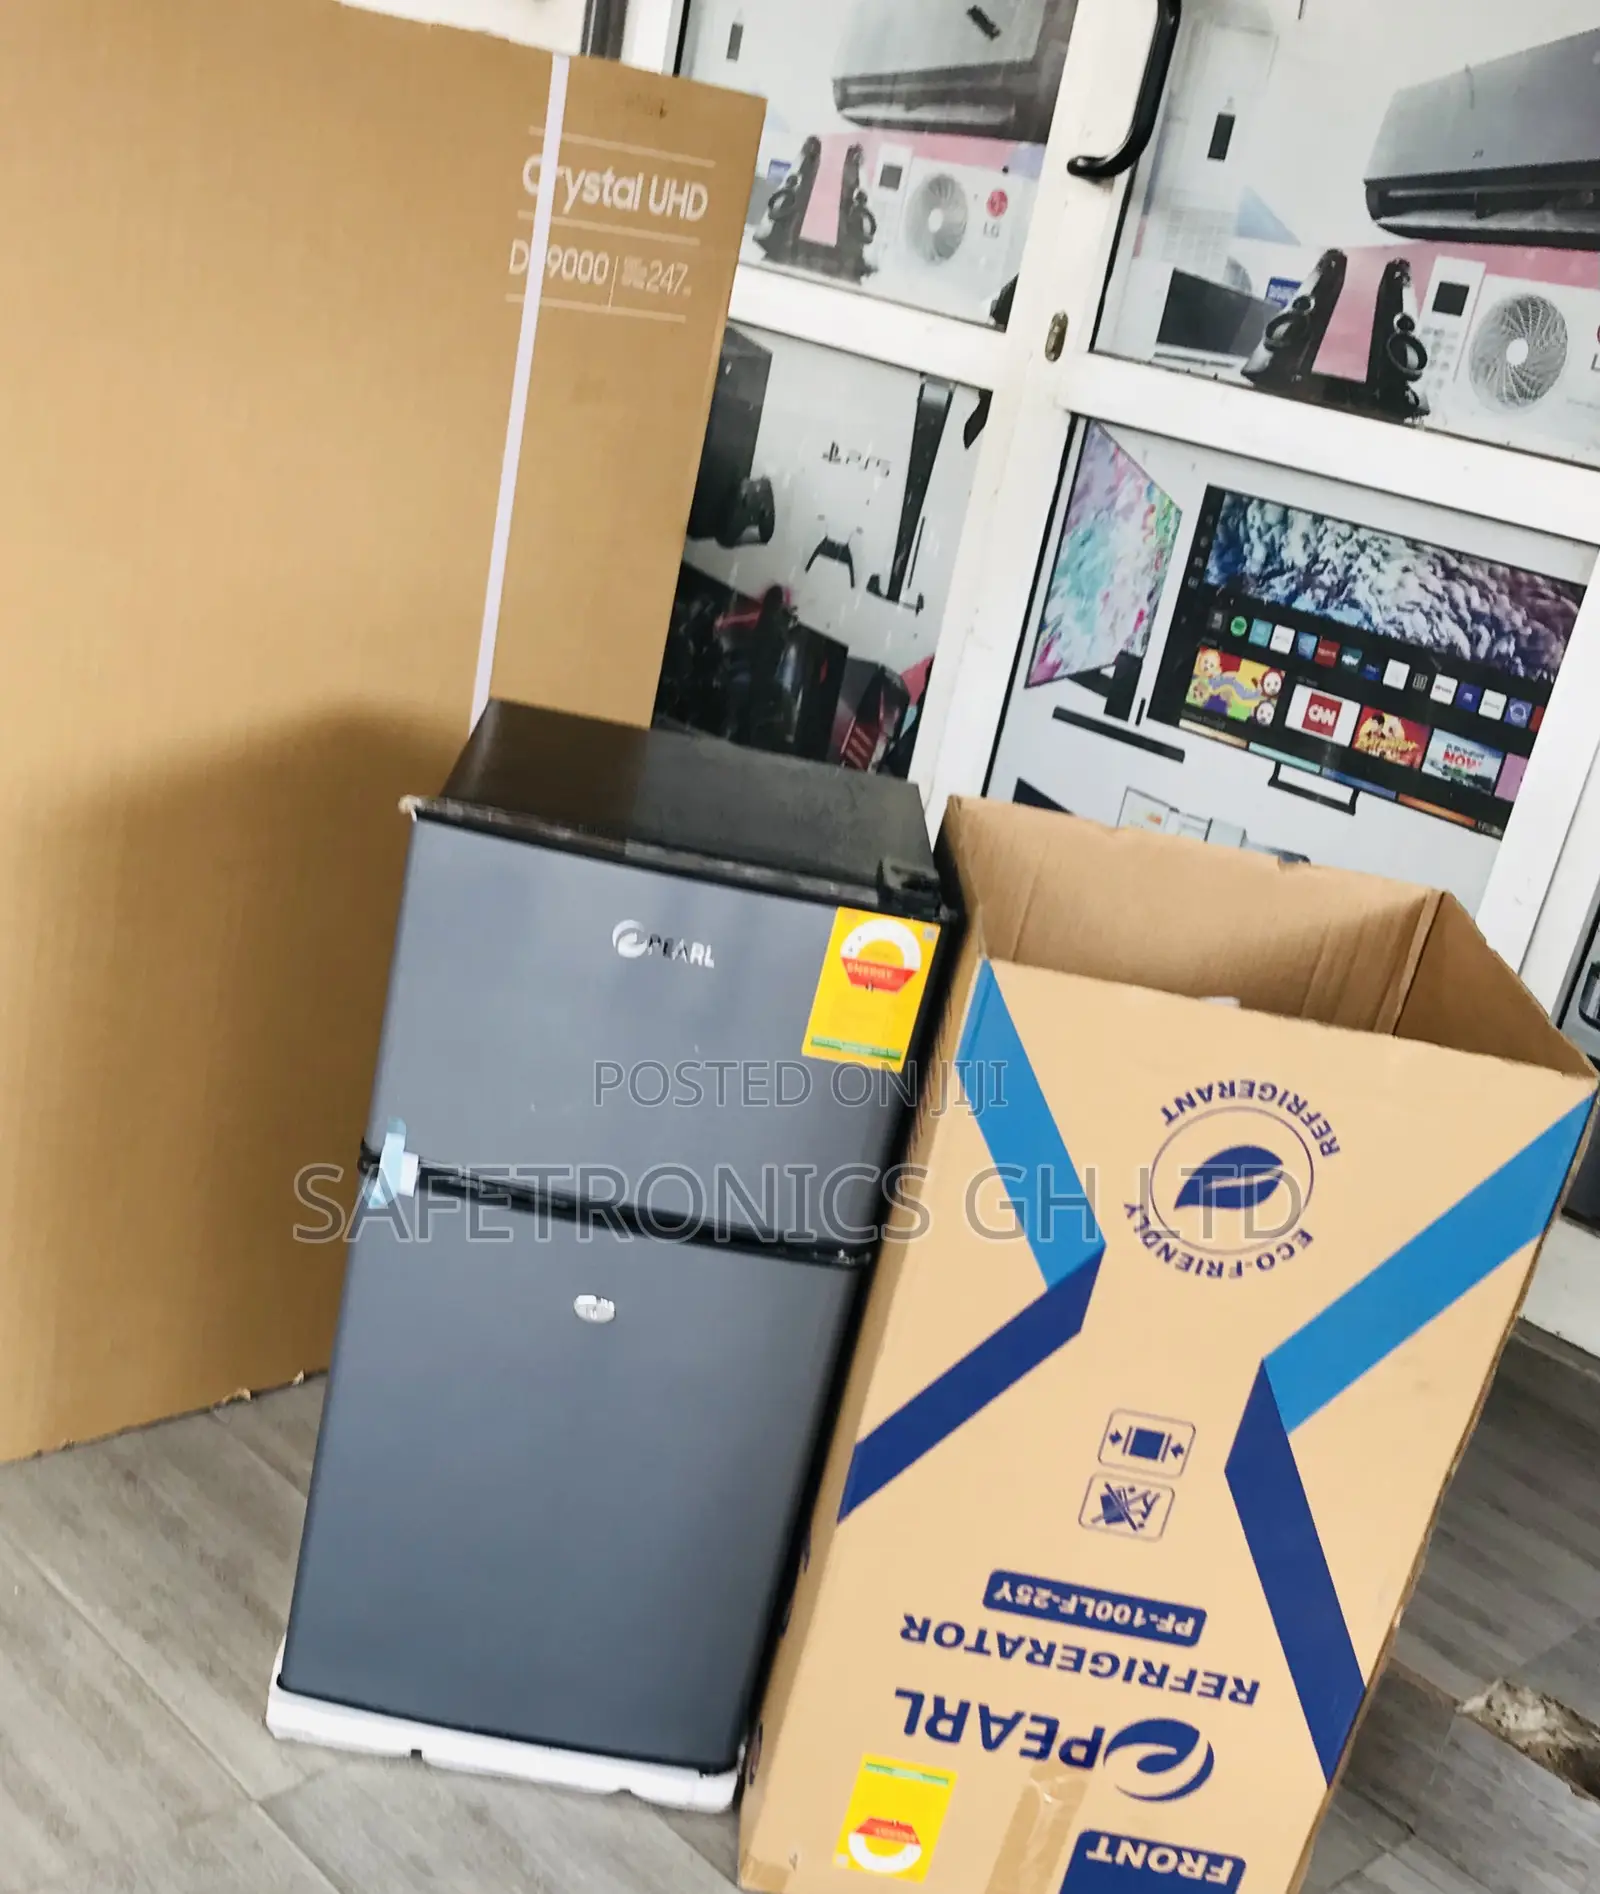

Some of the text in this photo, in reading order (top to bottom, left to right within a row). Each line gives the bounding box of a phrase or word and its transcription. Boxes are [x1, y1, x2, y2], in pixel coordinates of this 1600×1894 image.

[649, 174, 709, 222] UHD
[508, 239, 610, 285] D9000
[1160, 1079, 1341, 1158] REFRIGERANT
[1123, 1200, 1314, 1279] ECO-FRIENDLY
[993, 1579, 1197, 1639] PF-100LF-25Y
[899, 1612, 1261, 1707] REFRIGERATOR
[895, 1687, 1107, 1770] PEARL
[1086, 1835, 1235, 1886] FRONT
